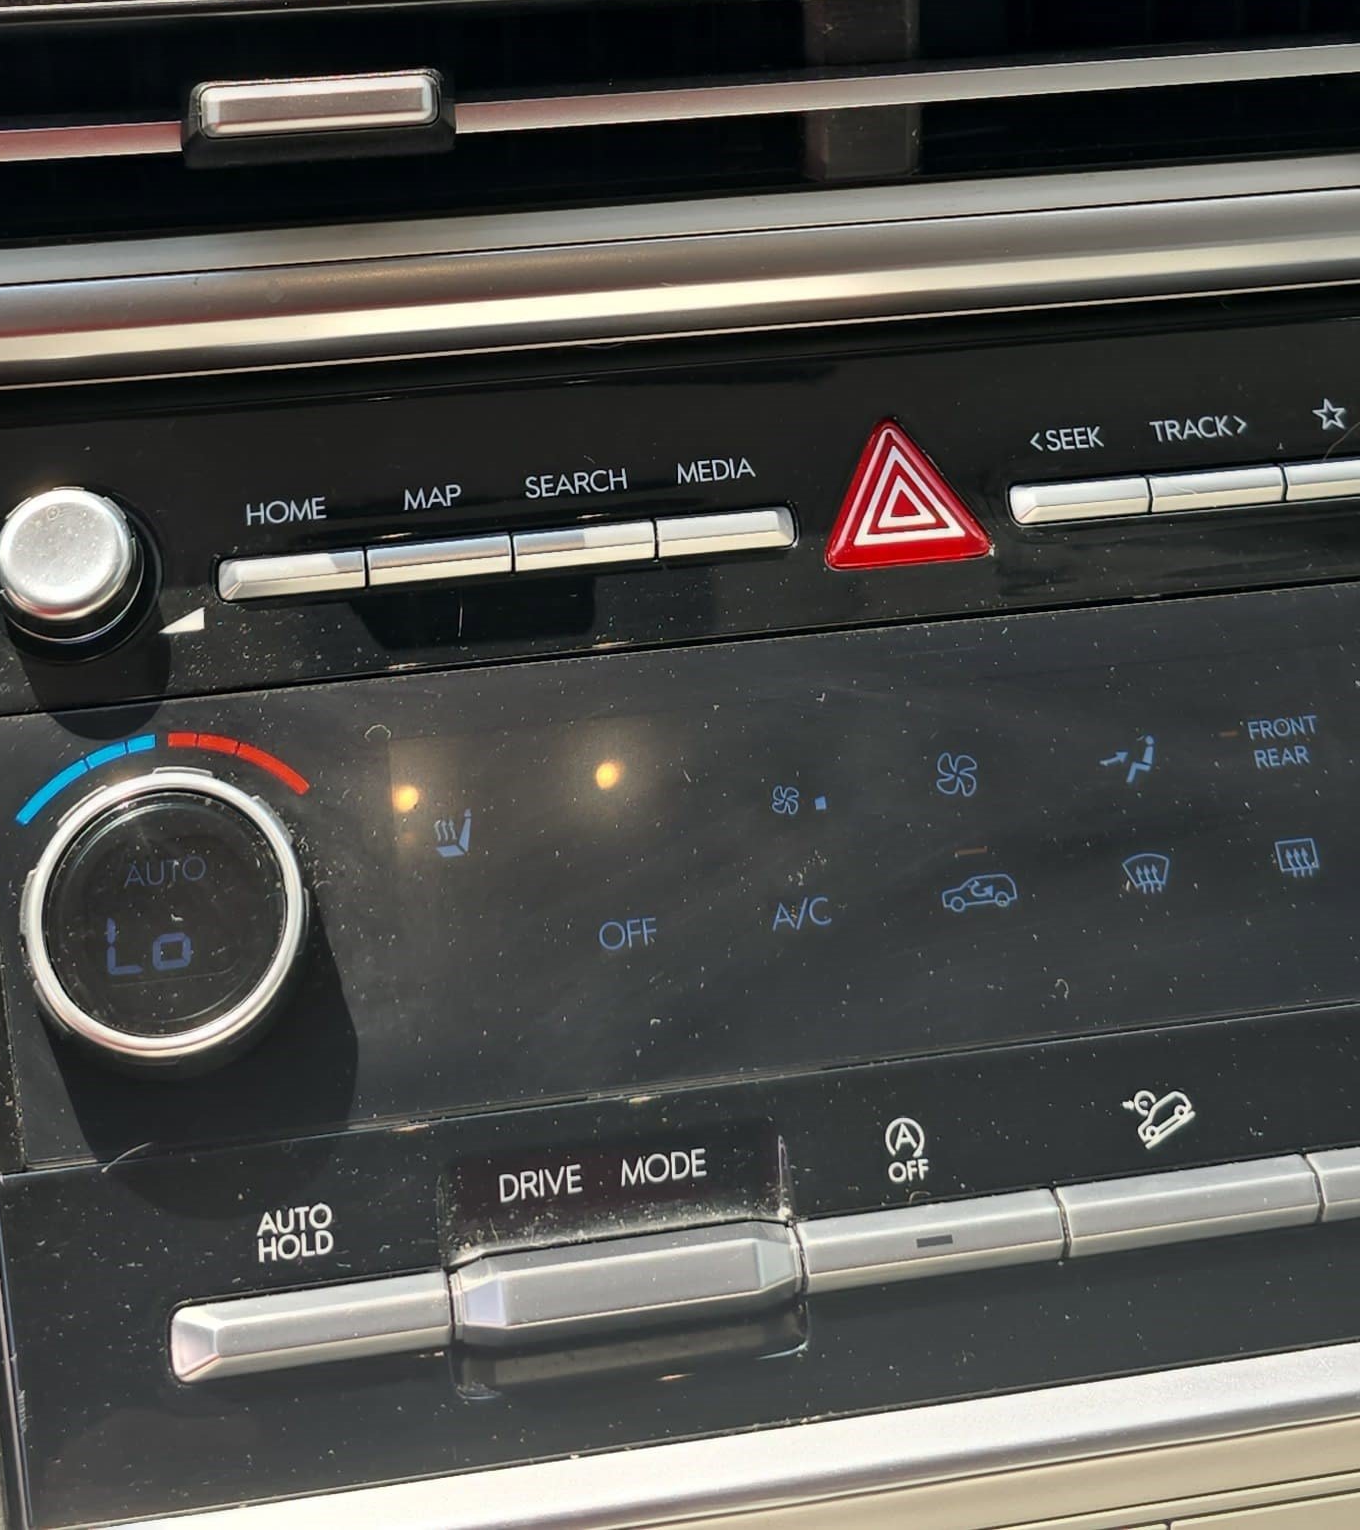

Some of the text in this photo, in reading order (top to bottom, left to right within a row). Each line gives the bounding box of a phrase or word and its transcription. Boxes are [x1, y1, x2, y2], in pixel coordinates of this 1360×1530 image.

[524, 466, 629, 500] SEARCH
[676, 456, 757, 487] MEDIA
[245, 495, 329, 528] HOME
[403, 483, 463, 513] MAP
[1246, 713, 1319, 742] FRONT
[1252, 743, 1311, 770] REAR
[123, 855, 208, 889] AUTO
[771, 894, 834, 933] A/C
[597, 915, 659, 952] OFF
[497, 1146, 709, 1204] DRIVE MODE
[886, 1155, 932, 1184] OFF
[255, 1200, 334, 1238] AUTO
[256, 1228, 335, 1264] HOLD
